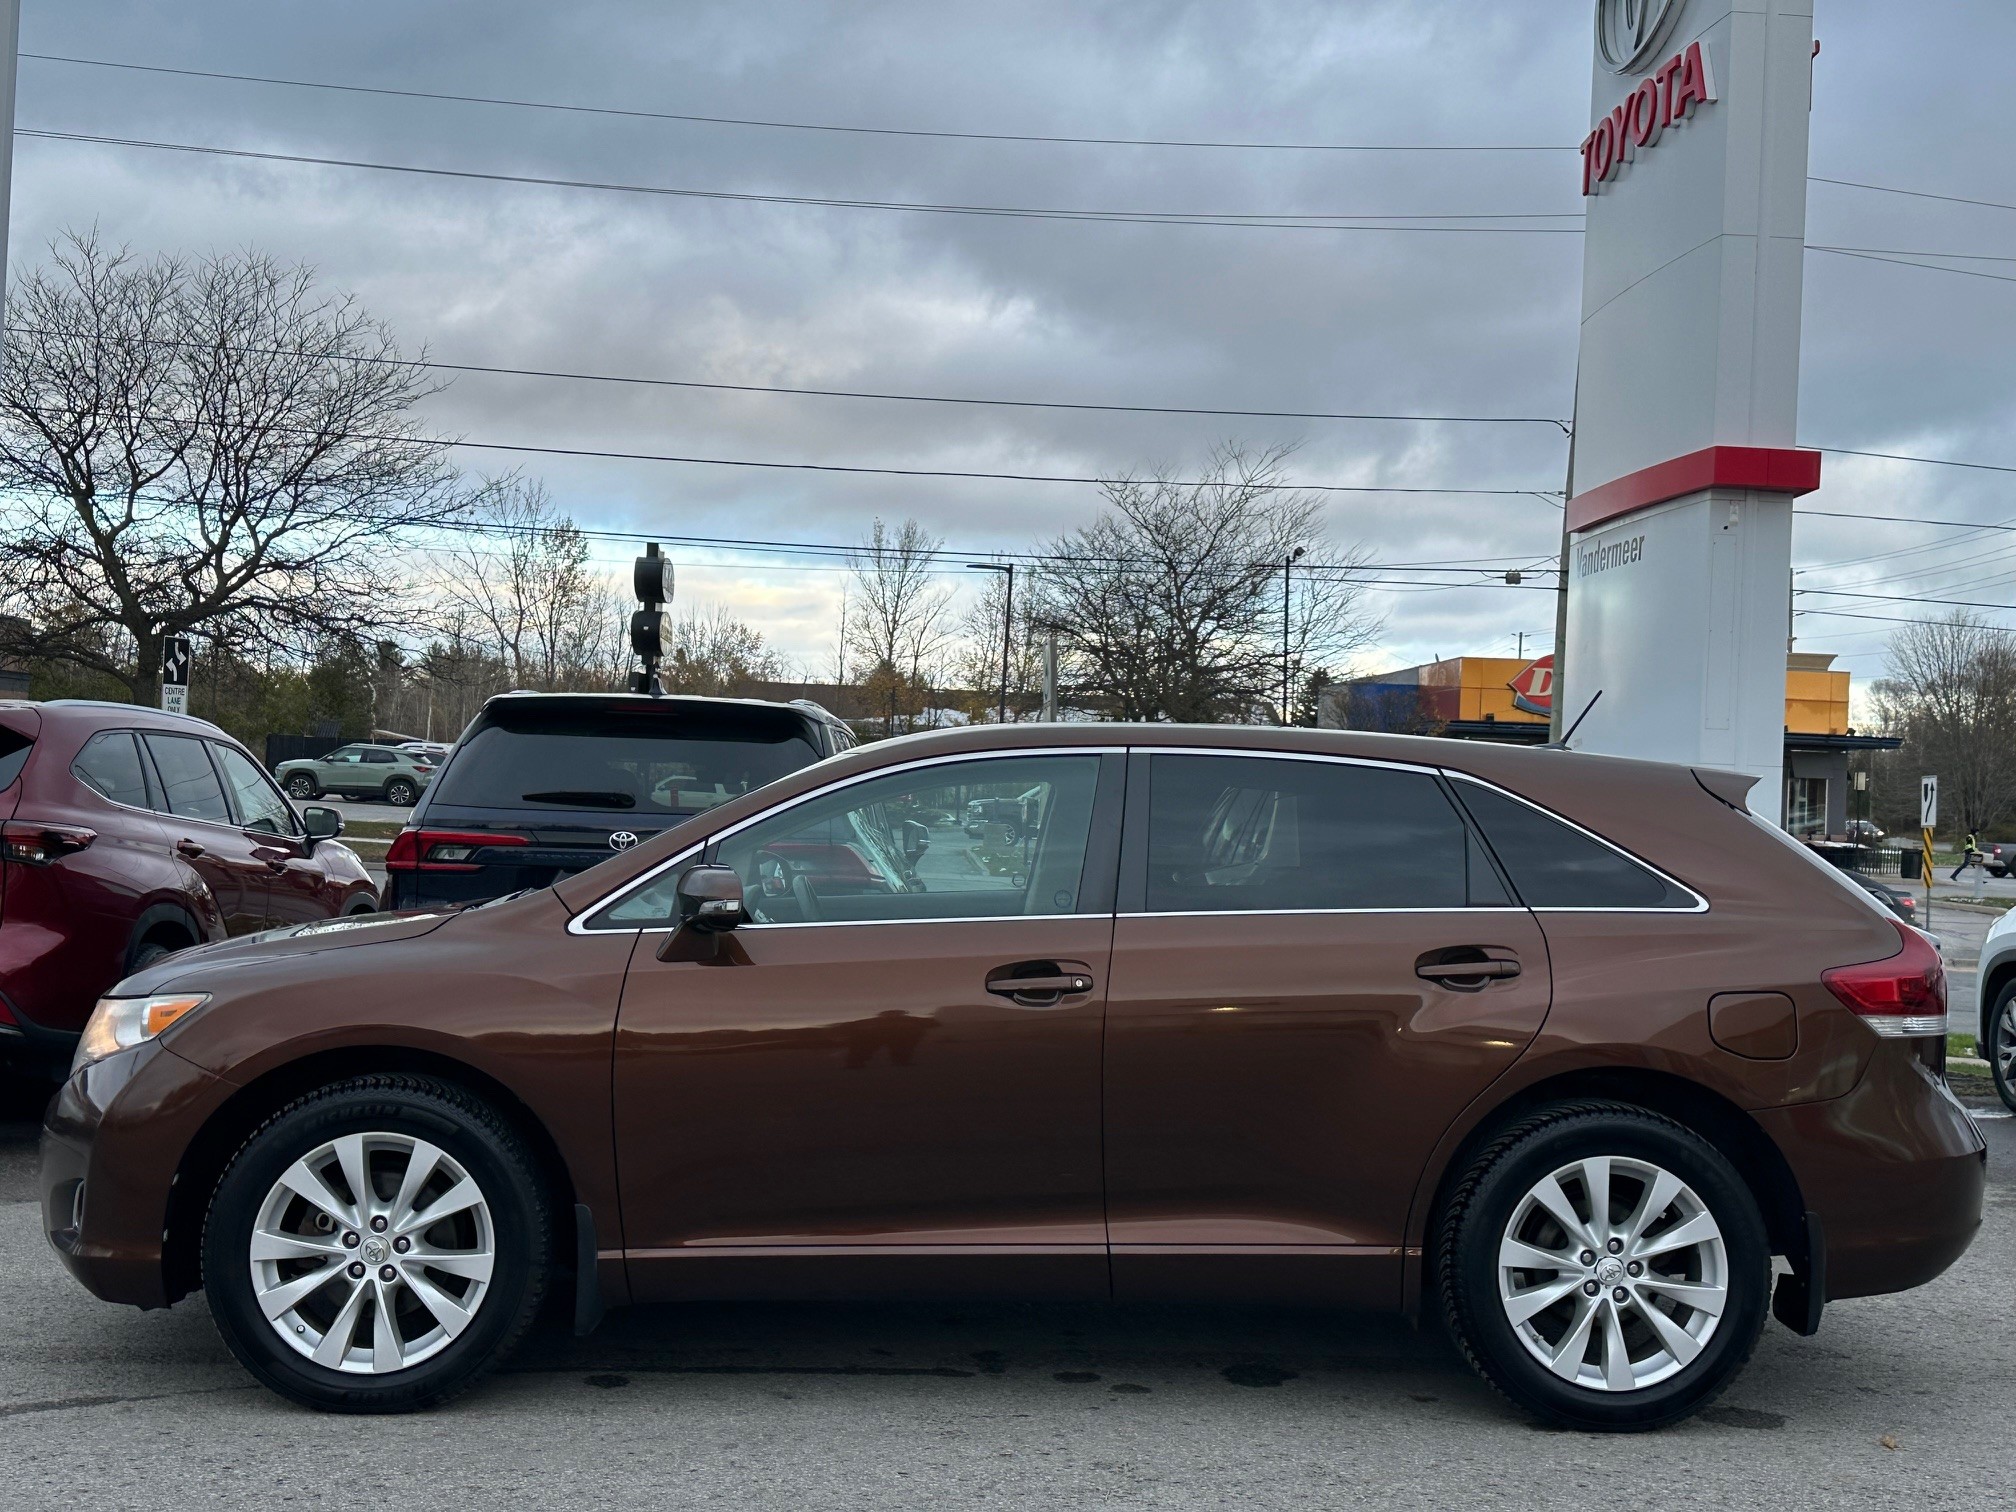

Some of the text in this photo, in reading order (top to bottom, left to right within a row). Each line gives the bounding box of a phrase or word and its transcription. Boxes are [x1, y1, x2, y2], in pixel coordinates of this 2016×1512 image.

[1580, 42, 1717, 196] TOYOTA
[1577, 535, 1645, 577] Vandermeer
[165, 686, 186, 696] CENTRE
[167, 697, 181, 705] LANE
